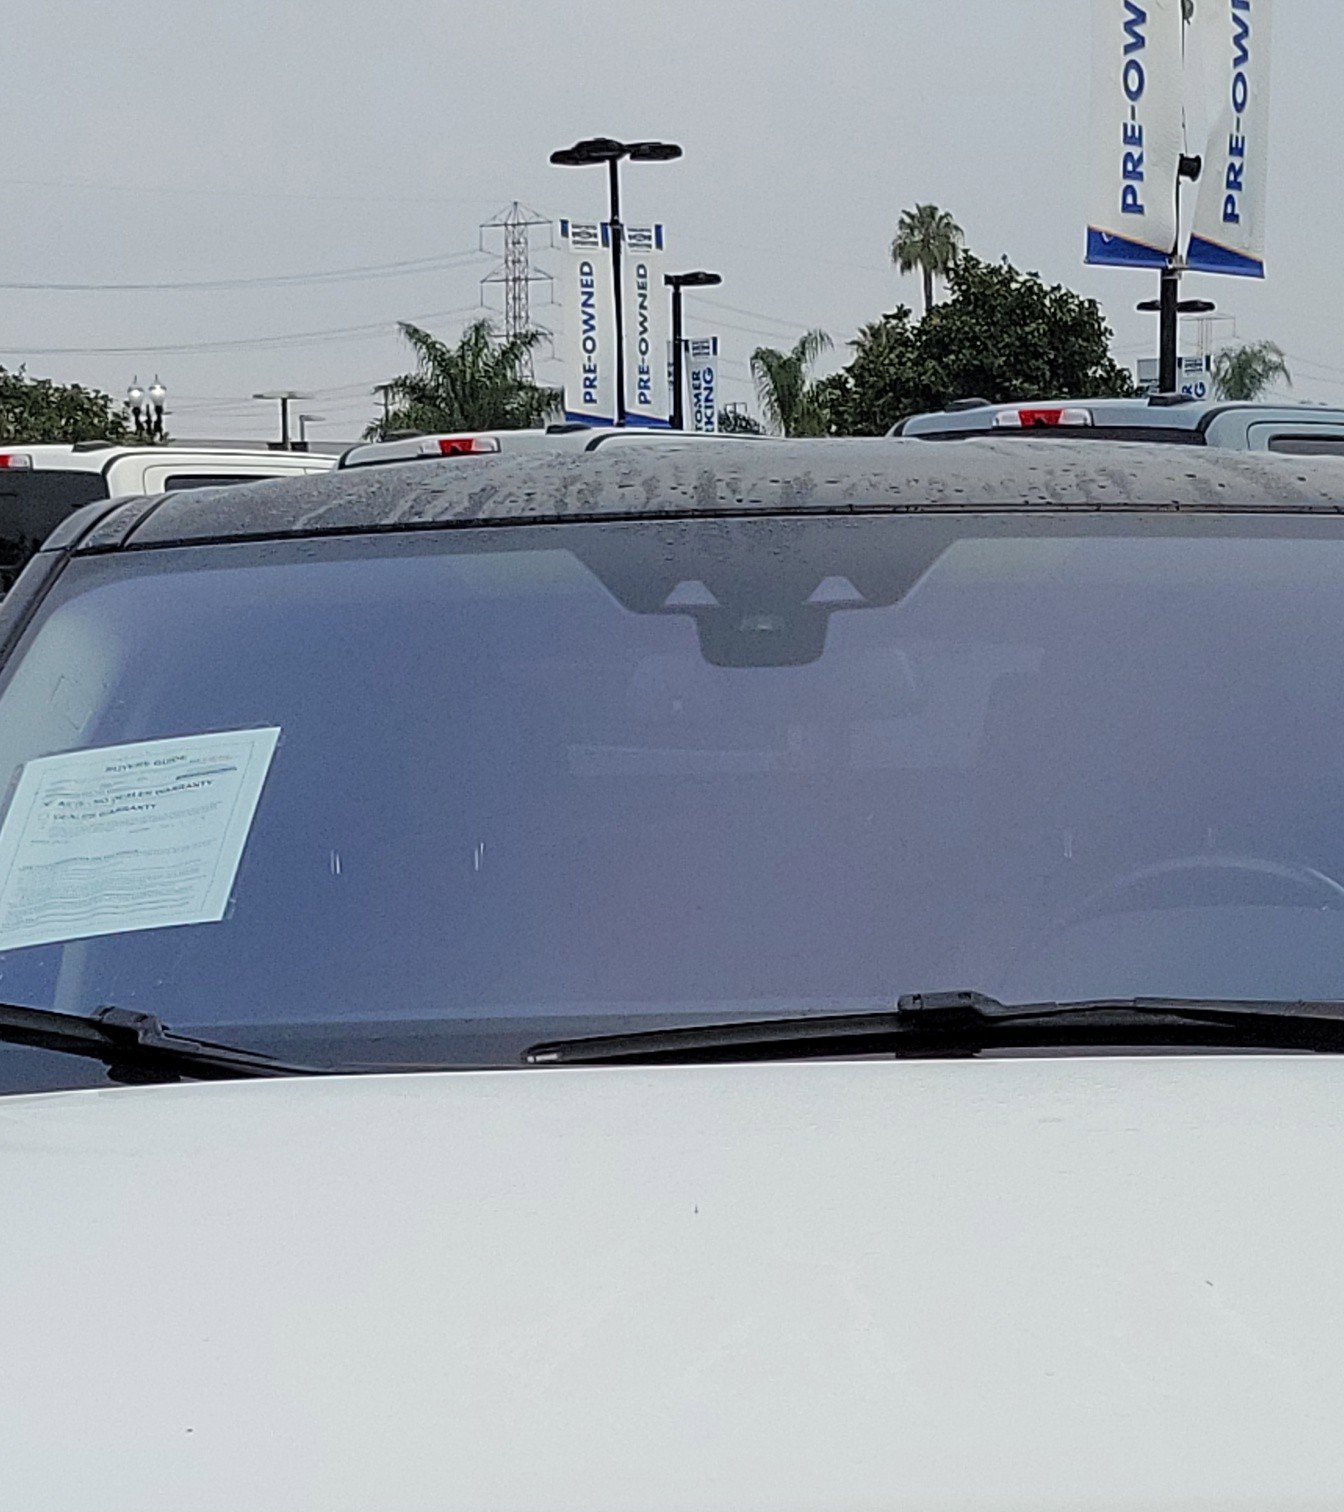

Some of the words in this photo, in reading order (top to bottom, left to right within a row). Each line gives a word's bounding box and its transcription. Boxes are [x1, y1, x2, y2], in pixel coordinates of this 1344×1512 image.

[1121, 0, 1146, 215] PRE-OW
[1223, 0, 1250, 224] PRE-OW
[579, 261, 598, 404] PRE-OWNED
[636, 264, 651, 405] PRE-OWNED
